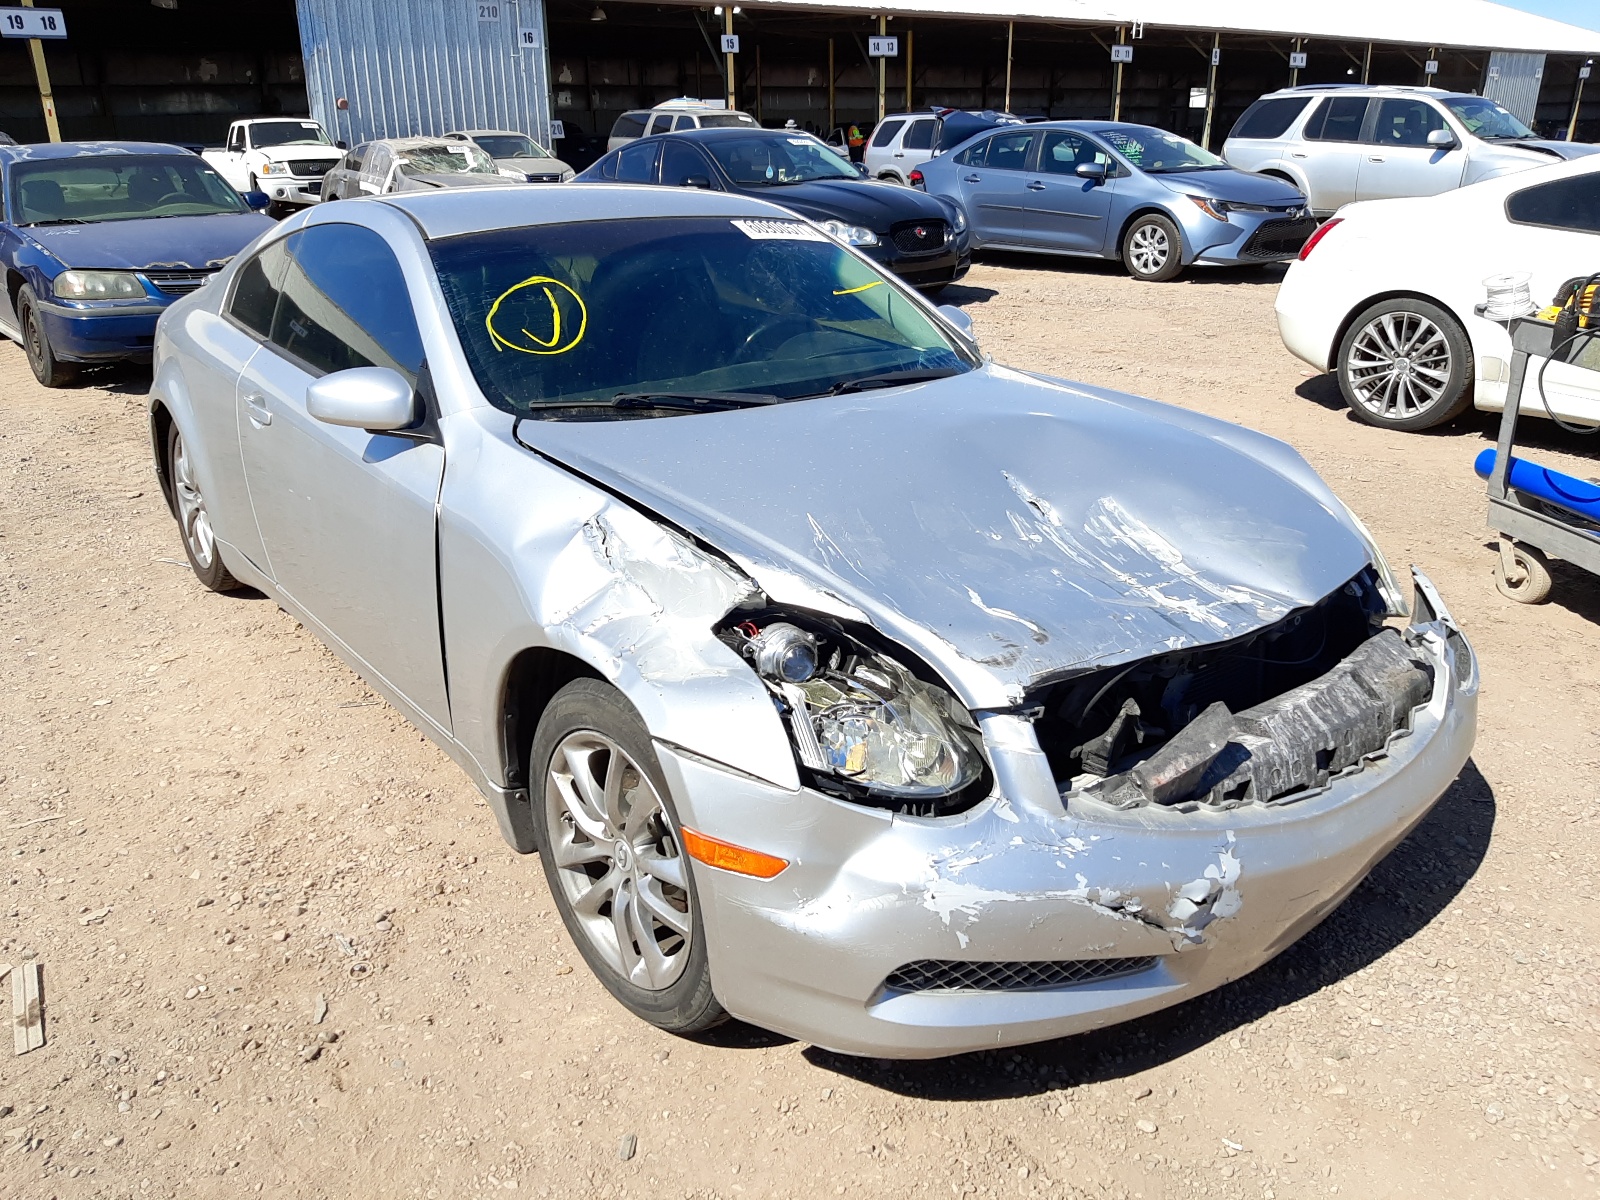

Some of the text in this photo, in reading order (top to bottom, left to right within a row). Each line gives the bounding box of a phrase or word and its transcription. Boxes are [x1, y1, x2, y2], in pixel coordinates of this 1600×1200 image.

[479, 5, 498, 18] 210
[7, 14, 57, 31] 19 18
[523, 32, 534, 44] 16
[726, 38, 735, 50] 15
[872, 41, 894, 52] 14 13
[1114, 49, 1120, 58] 12
[551, 123, 563, 135] 20
